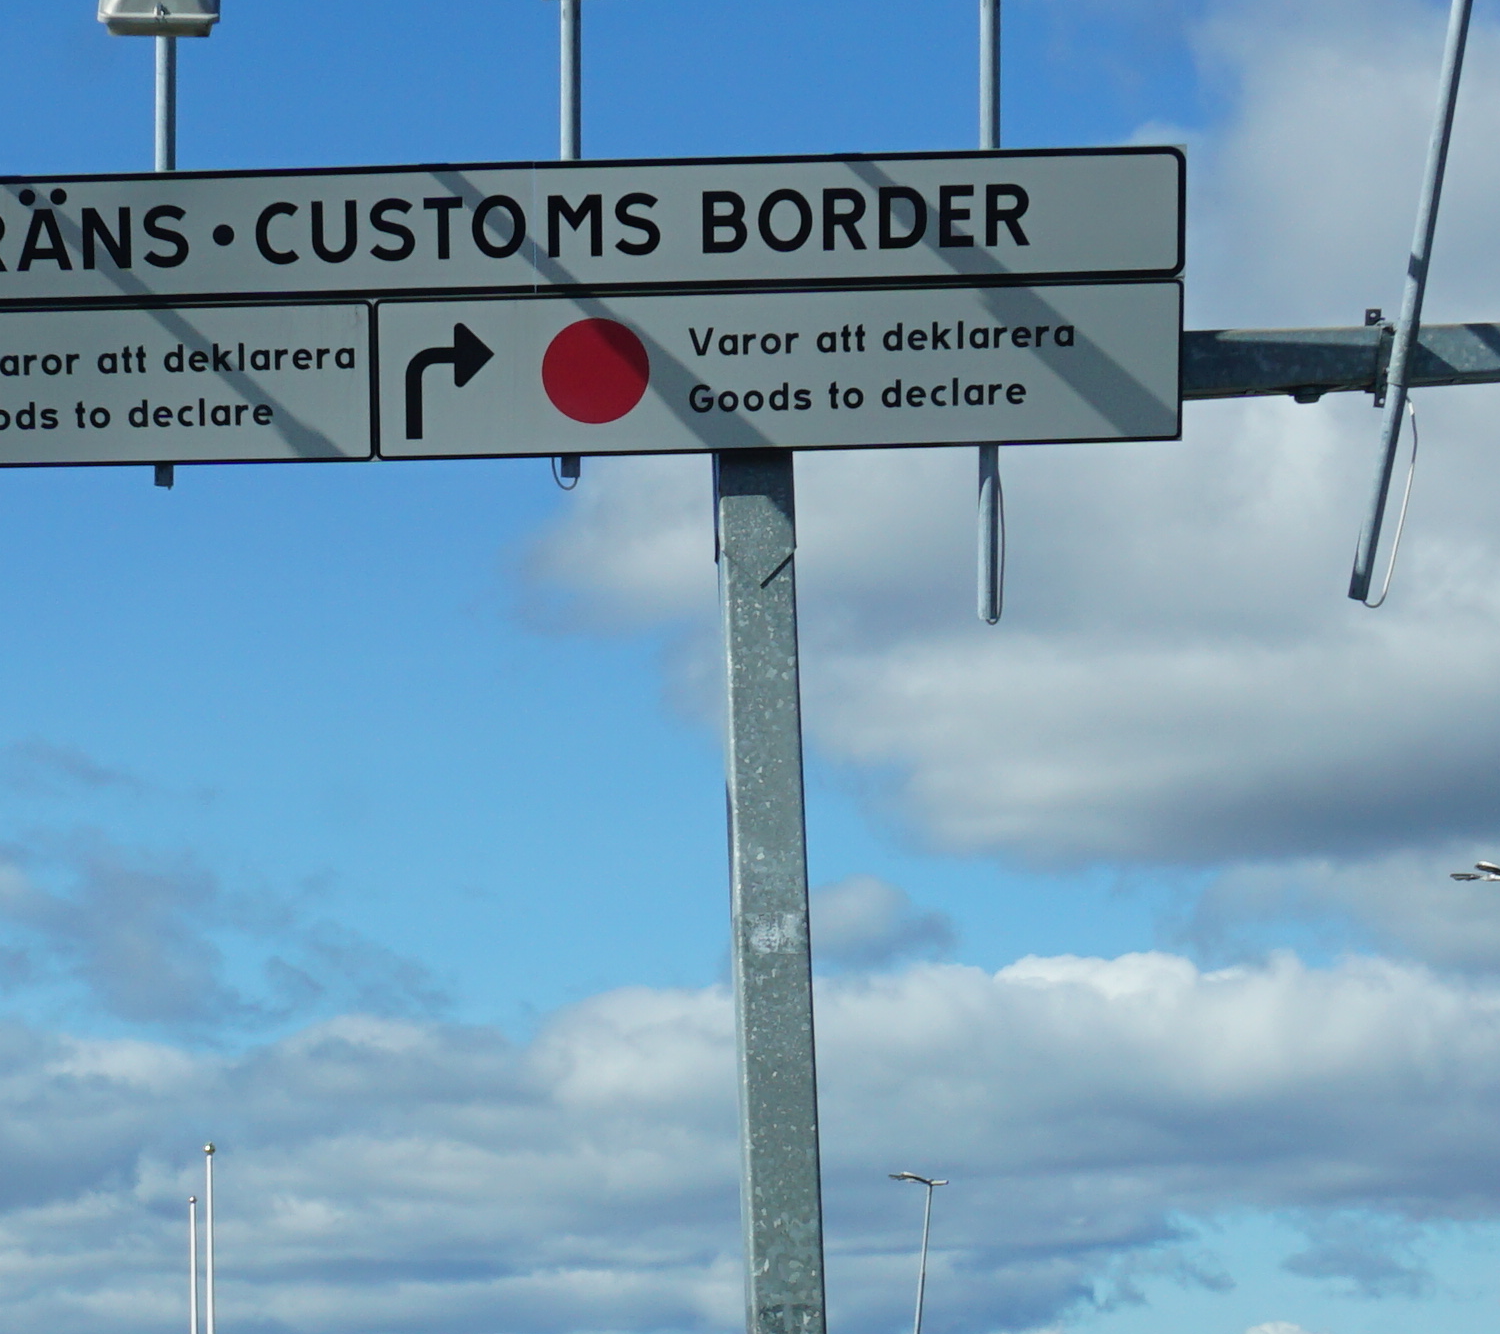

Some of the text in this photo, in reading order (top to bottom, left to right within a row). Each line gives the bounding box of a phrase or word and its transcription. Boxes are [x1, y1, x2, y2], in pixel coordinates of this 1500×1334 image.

[255, 192, 662, 265] CUSTOMS
[702, 183, 1031, 254] BORDER
[688, 320, 1075, 358] Varor att deklarera
[97, 345, 147, 375] att
[163, 342, 356, 373] deklarera
[75, 400, 112, 430] to
[128, 397, 274, 428] declare
[688, 377, 1027, 414] Goods to declare
